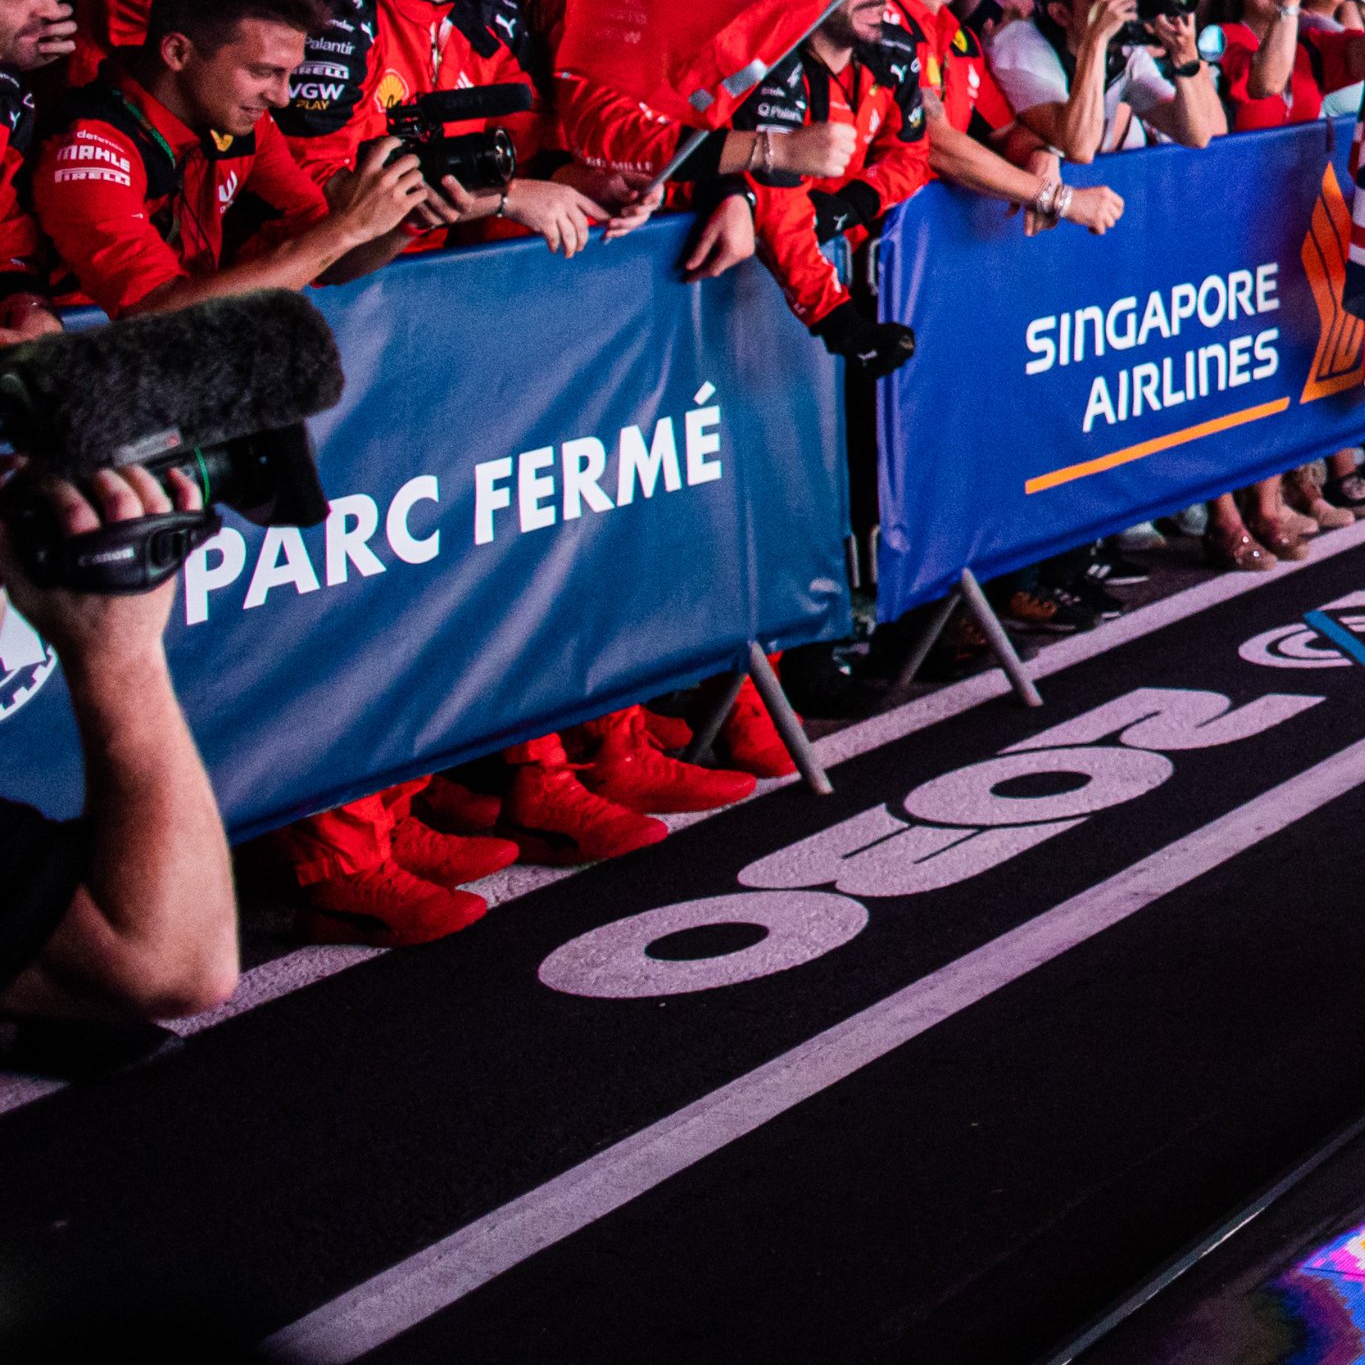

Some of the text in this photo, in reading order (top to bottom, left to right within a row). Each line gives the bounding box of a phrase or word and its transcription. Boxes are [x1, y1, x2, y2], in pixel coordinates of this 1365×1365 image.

[290, 60, 350, 80] IRELLI
[288, 82, 345, 101] VGW
[57, 145, 130, 173] MAHLE
[54, 167, 131, 187] PIRELLI
[1025, 262, 1280, 376] SINGAPORE
[1082, 327, 1280, 433] AIRLINES
[183, 380, 723, 625] PARC FERMÉ
